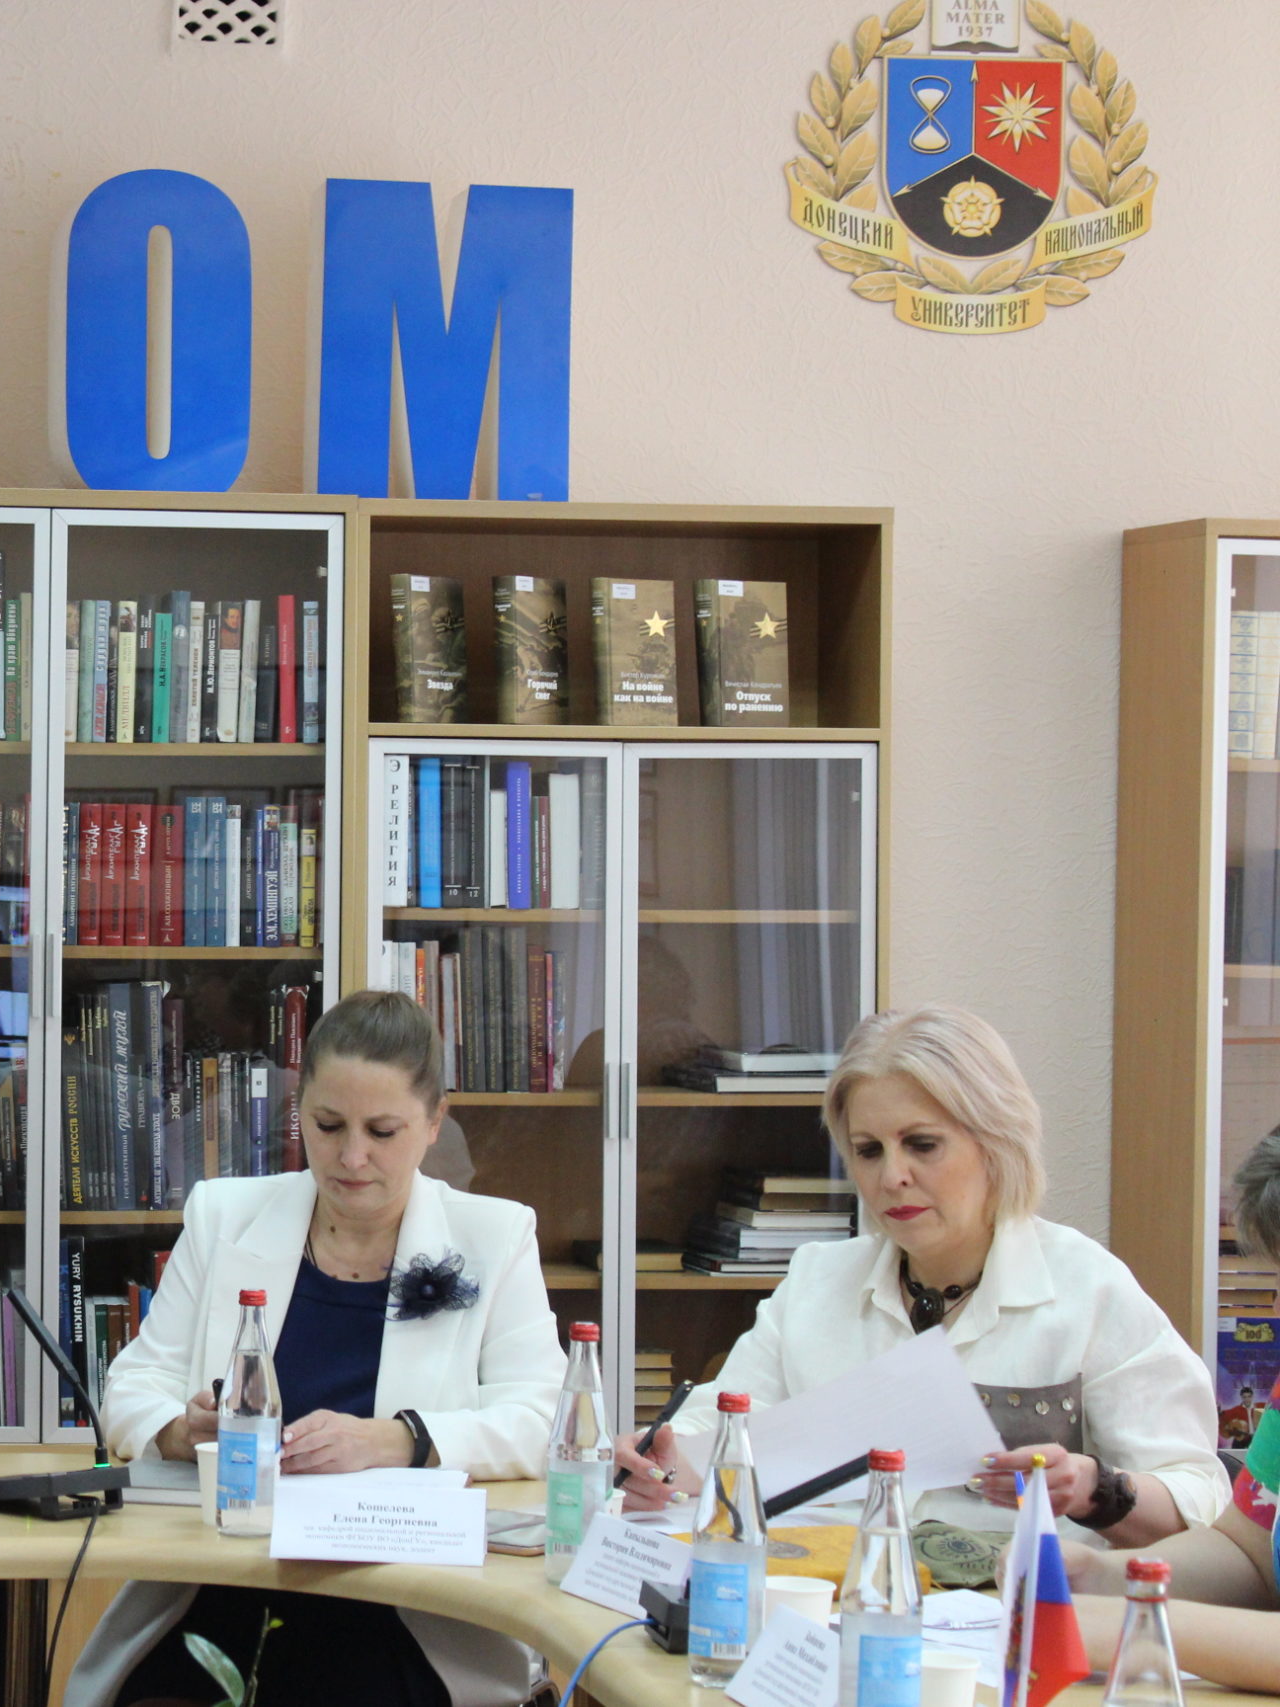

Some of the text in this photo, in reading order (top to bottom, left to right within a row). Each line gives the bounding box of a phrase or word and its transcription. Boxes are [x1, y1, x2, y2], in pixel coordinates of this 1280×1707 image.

[946, 11, 1006, 25] MATER
[957, 26, 994, 38] 1937
[802, 196, 1145, 257] ДОНЕЦКИЙ НАЦИОНАЛЬНЫЙ
[910, 295, 1031, 330] УНИВЕРСИТЕТ
[426, 678, 453, 692] Звезда
[527, 679, 558, 692] Горячий
[622, 681, 664, 693] На войне
[535, 691, 551, 701] снег
[614, 693, 673, 704] как на войне
[736, 691, 771, 703] Отпуск
[725, 702, 783, 713] по ранению
[389, 759, 401, 772] Э
[387, 784, 400, 887] РЕЛИГИЯ
[265, 870, 278, 923] ХЕМИНГУЭЙ
[448, 888, 459, 896] 10
[470, 889, 479, 898] 12
[170, 1092, 181, 1120] ДВОЕ
[66, 1075, 83, 1204] ДЕЯТЕЛИ ИСКУССТВ РОССИИ
[72, 1252, 83, 1342] YURY RYSUKHIN
[357, 1501, 415, 1514] Кошелева
[333, 1512, 438, 1527] Елена Георгиевна
